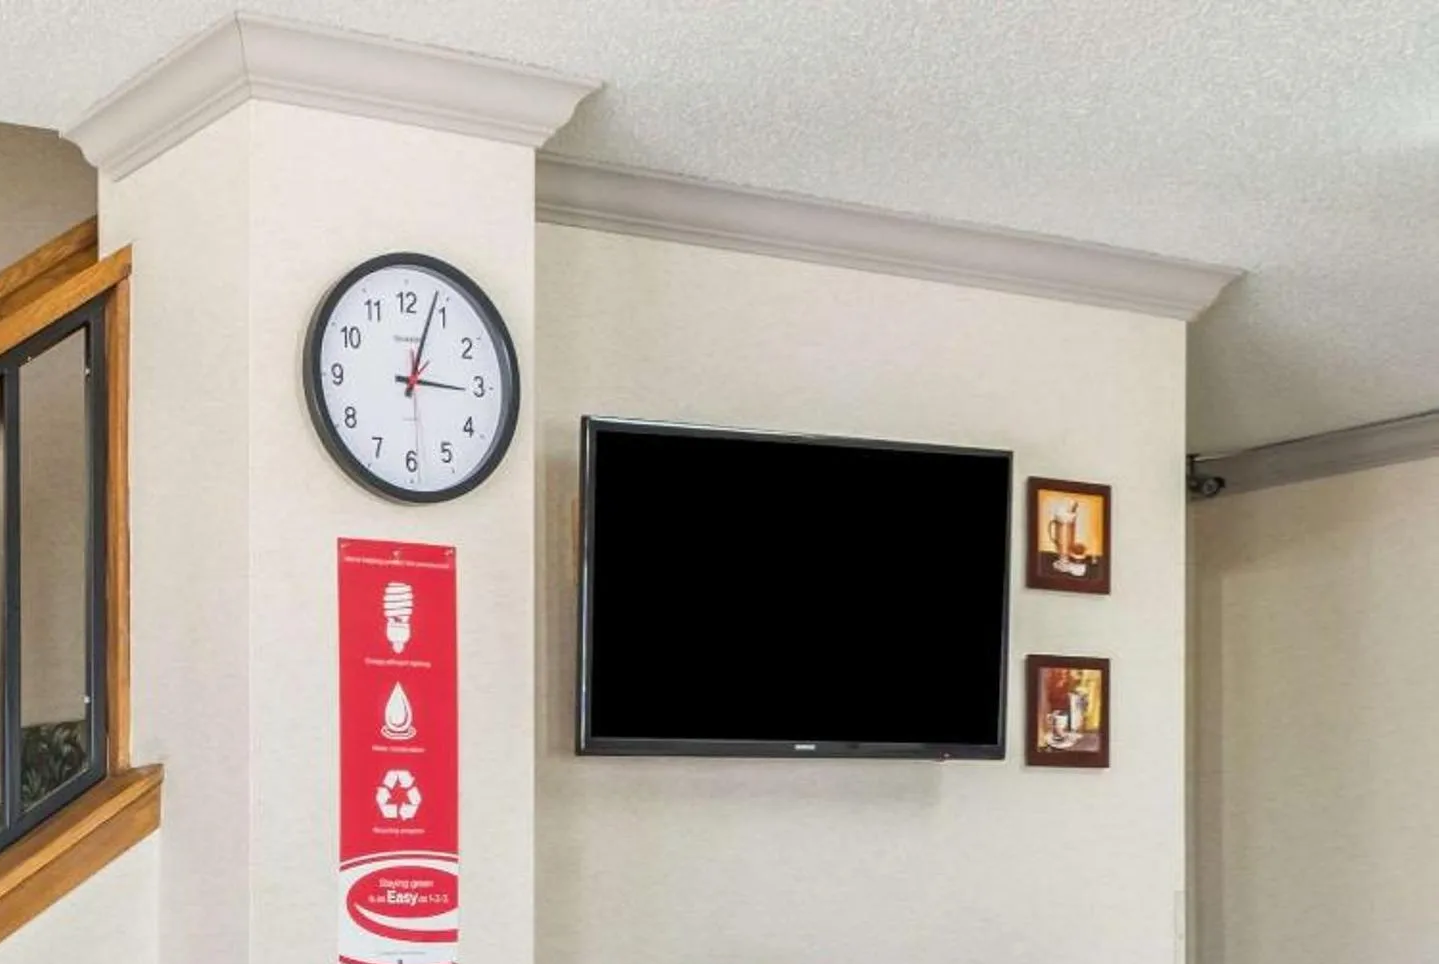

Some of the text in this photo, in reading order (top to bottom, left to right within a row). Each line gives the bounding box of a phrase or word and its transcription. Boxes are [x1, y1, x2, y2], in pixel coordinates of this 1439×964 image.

[364, 299, 382, 323] 11
[396, 291, 417, 314] 12
[438, 307, 447, 329] 1
[340, 326, 361, 349] 10
[461, 337, 474, 360] 2
[331, 363, 344, 386] 9
[473, 375, 485, 398] 3
[344, 406, 357, 429] 8
[463, 416, 474, 437] 4
[371, 437, 383, 459] 7
[441, 441, 453, 463] 5
[405, 450, 418, 473] 6
[387, 890, 418, 906] Easy
